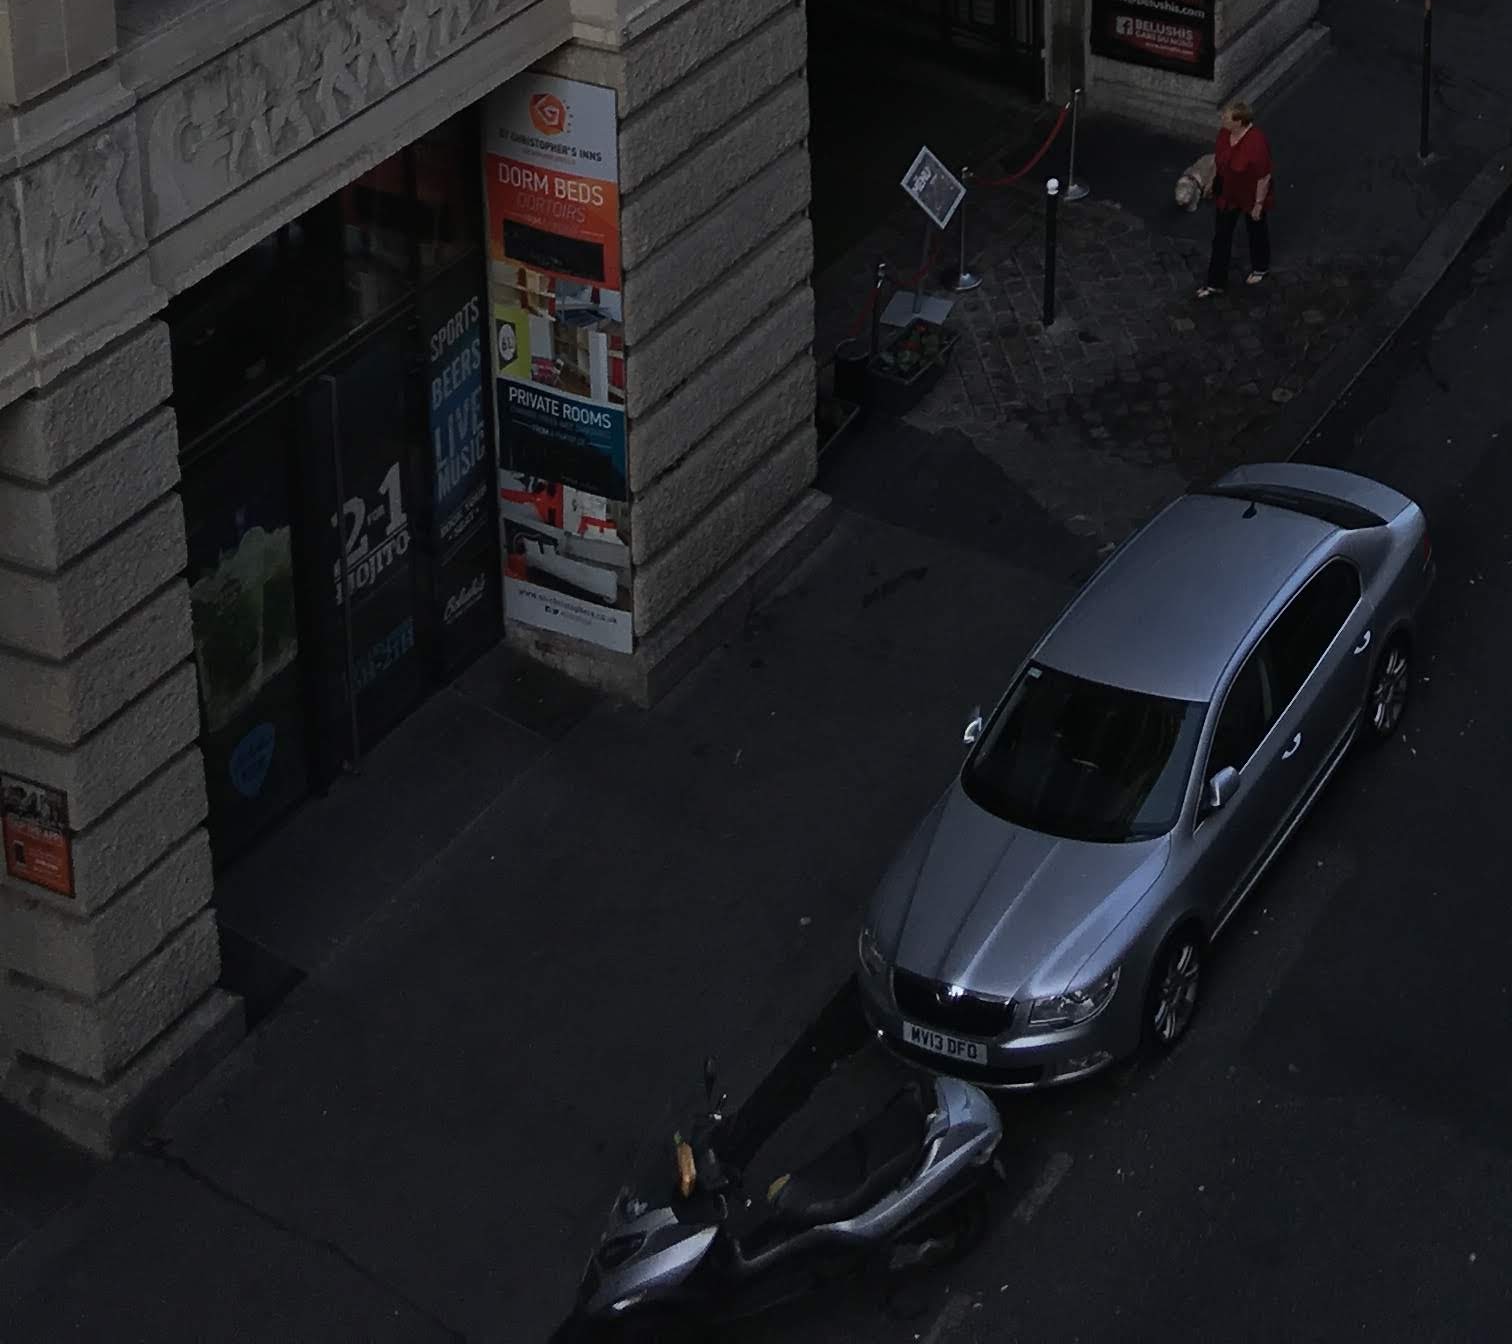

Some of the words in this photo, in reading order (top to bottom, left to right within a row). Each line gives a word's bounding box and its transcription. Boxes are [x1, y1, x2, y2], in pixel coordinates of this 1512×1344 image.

[1135, 17, 1194, 41] BELUSHIS
[579, 148, 602, 164] INNS
[498, 162, 550, 196] DORM
[554, 176, 604, 206] BEDS
[430, 296, 481, 363] SPORTS
[432, 338, 481, 411] BEERS
[435, 385, 483, 460] LIVE
[509, 386, 561, 417] PRIVATE
[563, 402, 613, 429] ROOMS
[438, 420, 487, 504] MUSIC
[911, 1025, 944, 1051] MV13
